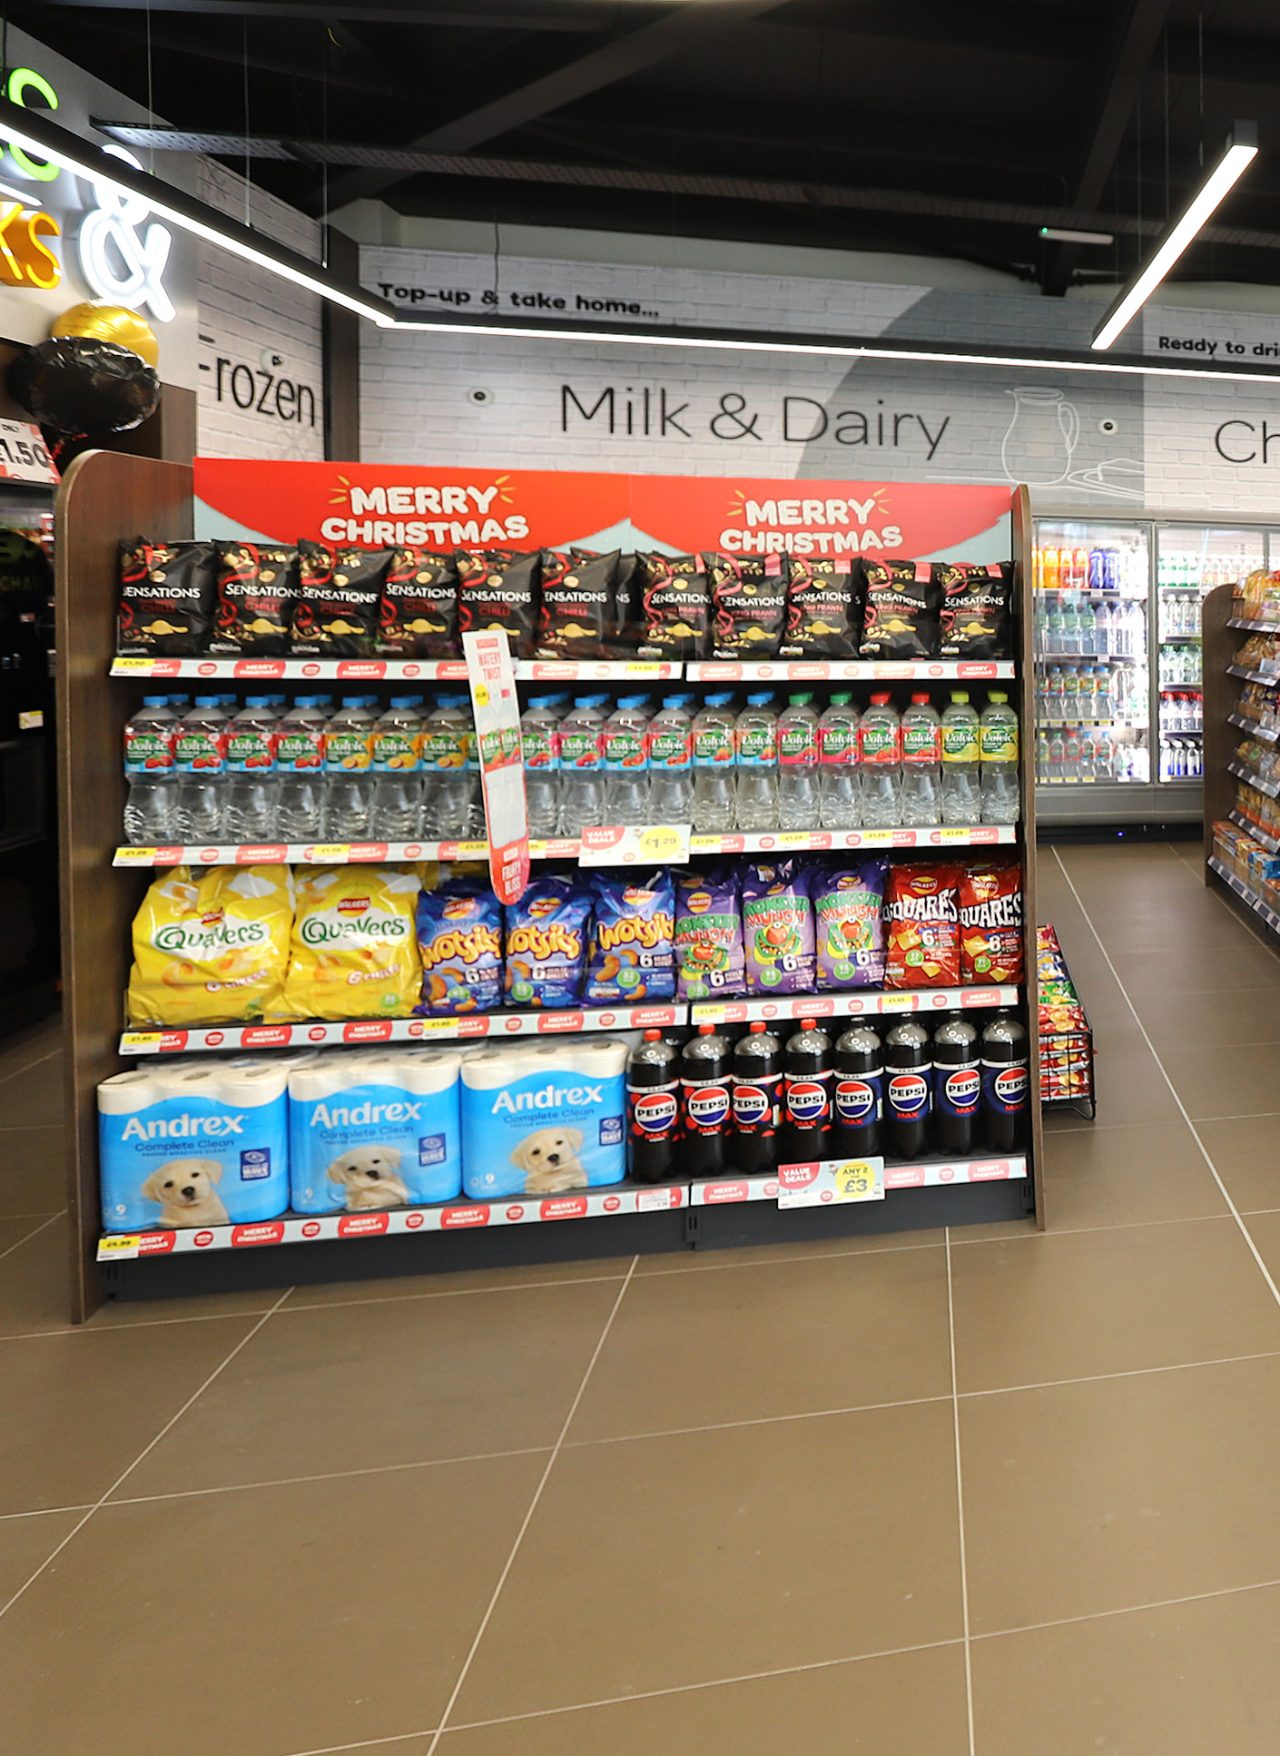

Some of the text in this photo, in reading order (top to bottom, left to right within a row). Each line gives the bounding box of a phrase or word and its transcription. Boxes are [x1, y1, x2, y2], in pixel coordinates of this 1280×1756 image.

[378, 282, 660, 317] Top-up & take home...
[1158, 336, 1218, 356] Ready
[1225, 341, 1247, 356] to
[199, 335, 314, 428] rozen
[561, 384, 951, 461] Milk & Dairy
[350, 485, 499, 515] MERRY
[745, 497, 877, 526] MERRY
[320, 515, 529, 546] CHRISTMAS
[719, 525, 903, 555] CHRISTMAS
[301, 587, 378, 603] SENSATIONS
[386, 583, 457, 600] SENSATIONS
[544, 591, 607, 603] ENSATIONS
[868, 592, 927, 609] SENSATIONS
[945, 595, 1004, 606] SENSATIONS
[893, 888, 958, 922] QUARES
[960, 892, 1022, 928] QUARES
[155, 921, 264, 950] Quavers
[301, 916, 406, 945] Quavers
[598, 913, 675, 951] Wotsit
[921, 930, 935, 945] 6
[507, 924, 581, 960] otsits
[989, 935, 1001, 951] 6
[640, 953, 653, 968] 6
[782, 955, 796, 971] 6
[857, 950, 870, 966] 6
[464, 968, 479, 984] 6
[532, 964, 546, 980] 6
[710, 970, 724, 987] 6
[890, 1087, 925, 1098] PEPSI
[997, 1078, 1028, 1091] PEPS
[491, 1085, 604, 1115] Andrex
[690, 1097, 728, 1111] PEPSI
[788, 1094, 824, 1105] PEPSI
[836, 1093, 871, 1105] PEPSI
[310, 1101, 422, 1129] Andrex
[504, 1109, 595, 1124] Complete Clean
[638, 1103, 675, 1118] PEPSI
[121, 1113, 244, 1141] Andrex
[320, 1126, 414, 1141] Complete Clean
[135, 1137, 235, 1153] Complete Clean
[782, 1166, 811, 1177] VALUE
[784, 1173, 812, 1184] DEALS
[842, 1166, 869, 1176] ANY 2
[843, 1178, 868, 1193] £3
